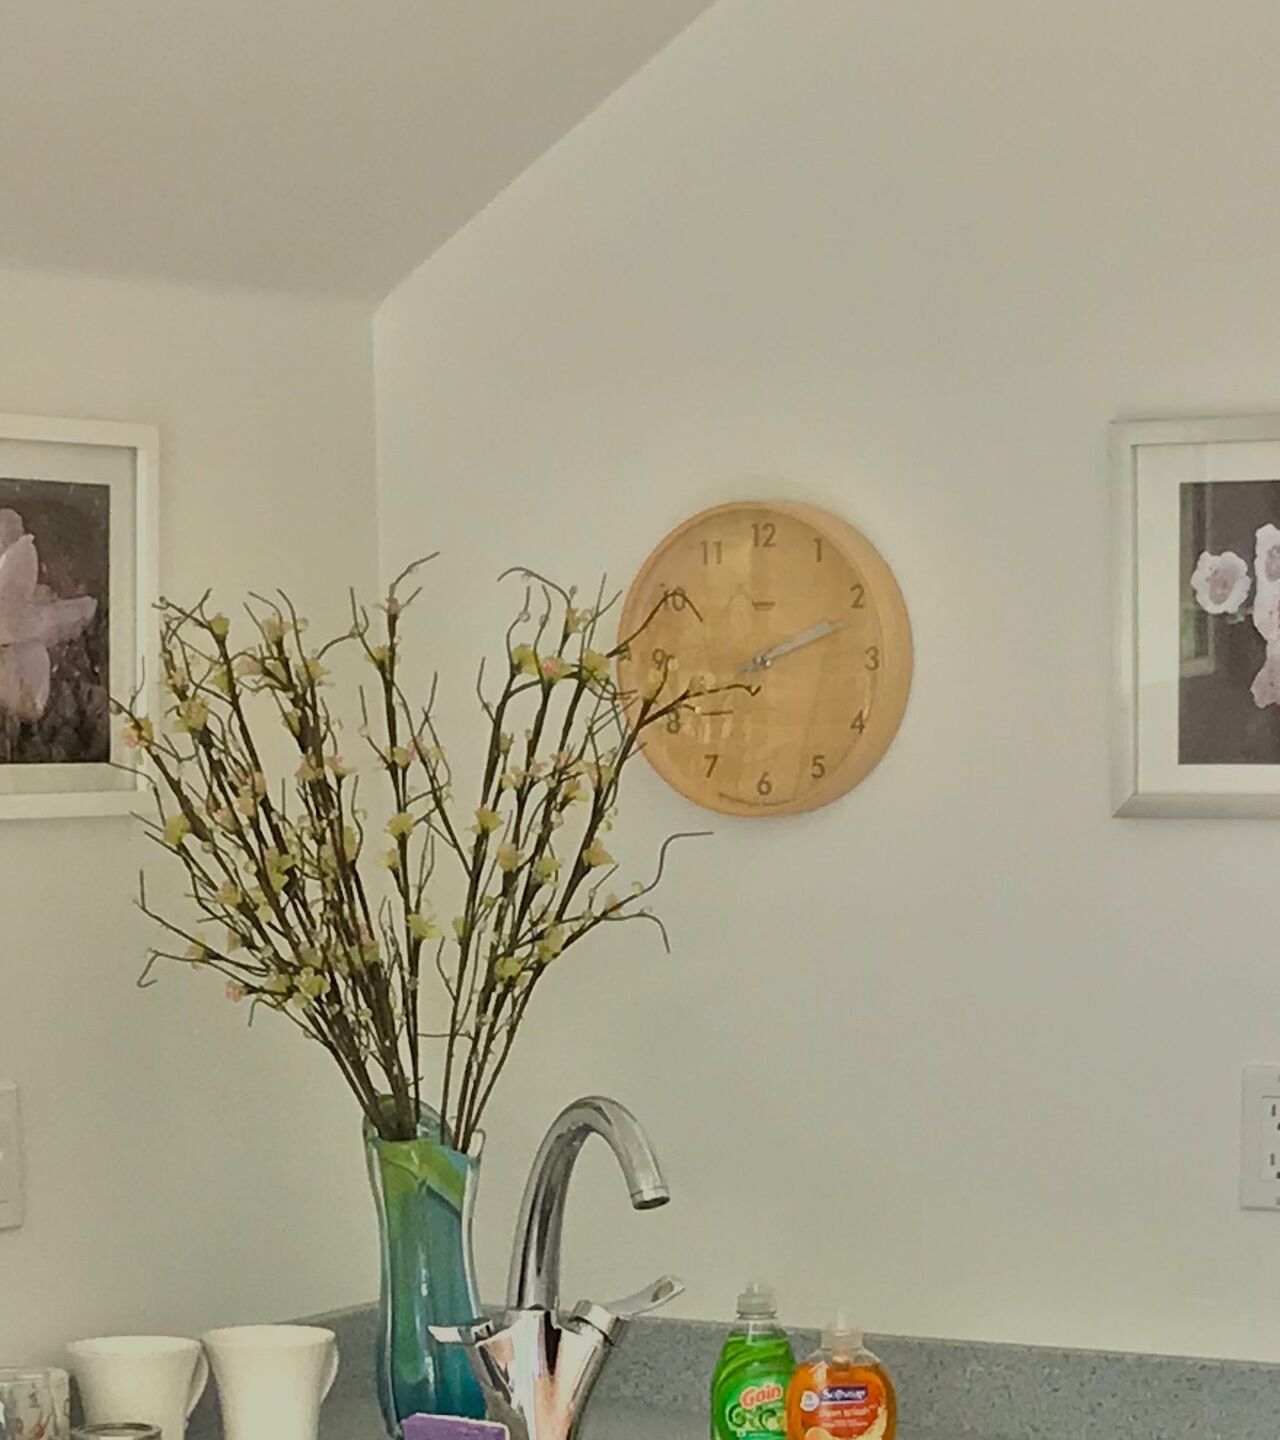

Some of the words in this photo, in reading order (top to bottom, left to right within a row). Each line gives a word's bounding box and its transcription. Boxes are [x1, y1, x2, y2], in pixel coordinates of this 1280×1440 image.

[752, 523, 776, 547] 12
[700, 540, 723, 565] 11
[814, 538, 823, 562] 1
[662, 586, 686, 612] 10
[850, 583, 865, 609] 2
[652, 648, 666, 671] 9
[865, 646, 879, 671] 3
[666, 706, 681, 734] 8
[850, 710, 865, 734] 4
[704, 754, 719, 778] 7
[811, 755, 826, 779] 5
[757, 772, 772, 796] 6
[740, 1384, 783, 1410] Gain
